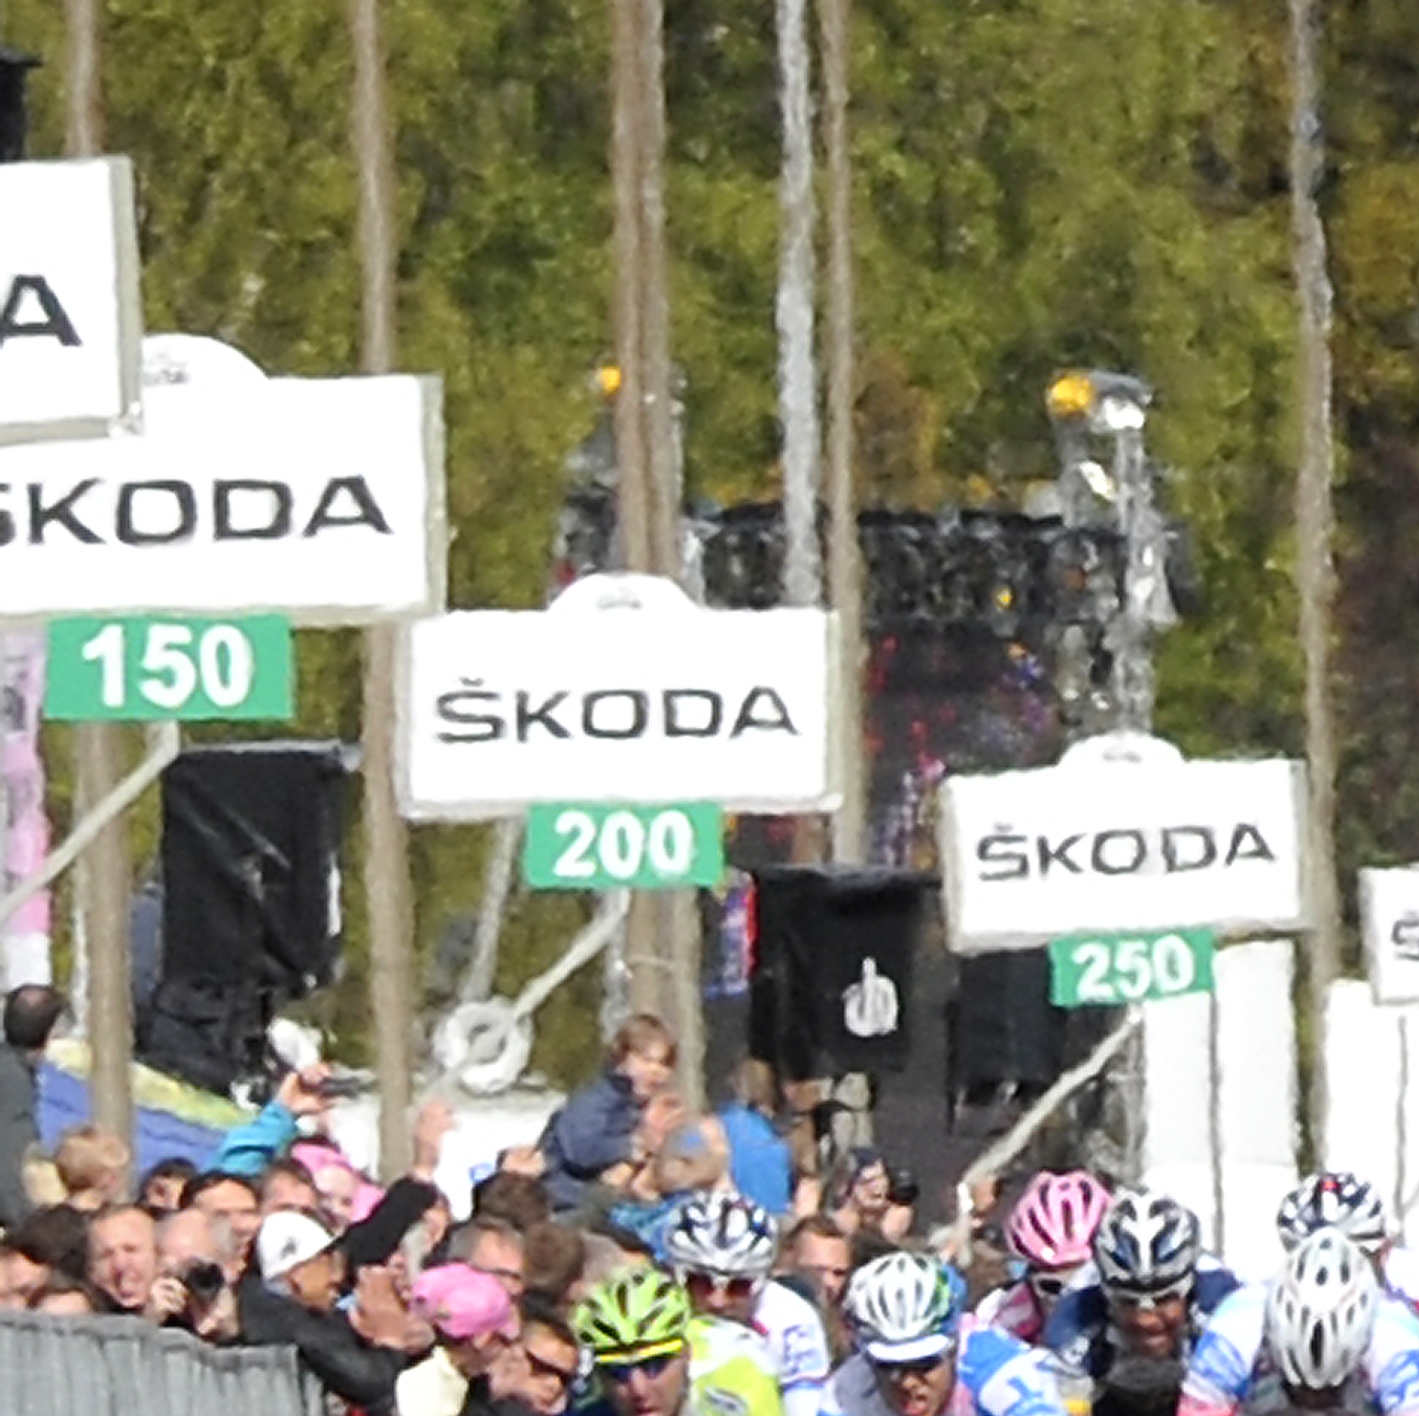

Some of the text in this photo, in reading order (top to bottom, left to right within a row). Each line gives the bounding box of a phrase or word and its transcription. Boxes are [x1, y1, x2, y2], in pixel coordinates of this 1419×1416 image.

[81, 624, 254, 709] 150
[436, 677, 798, 743] ŠKODA
[552, 810, 695, 879] 200
[977, 822, 1277, 883] ŠKODA
[1072, 935, 1196, 1000] 250
